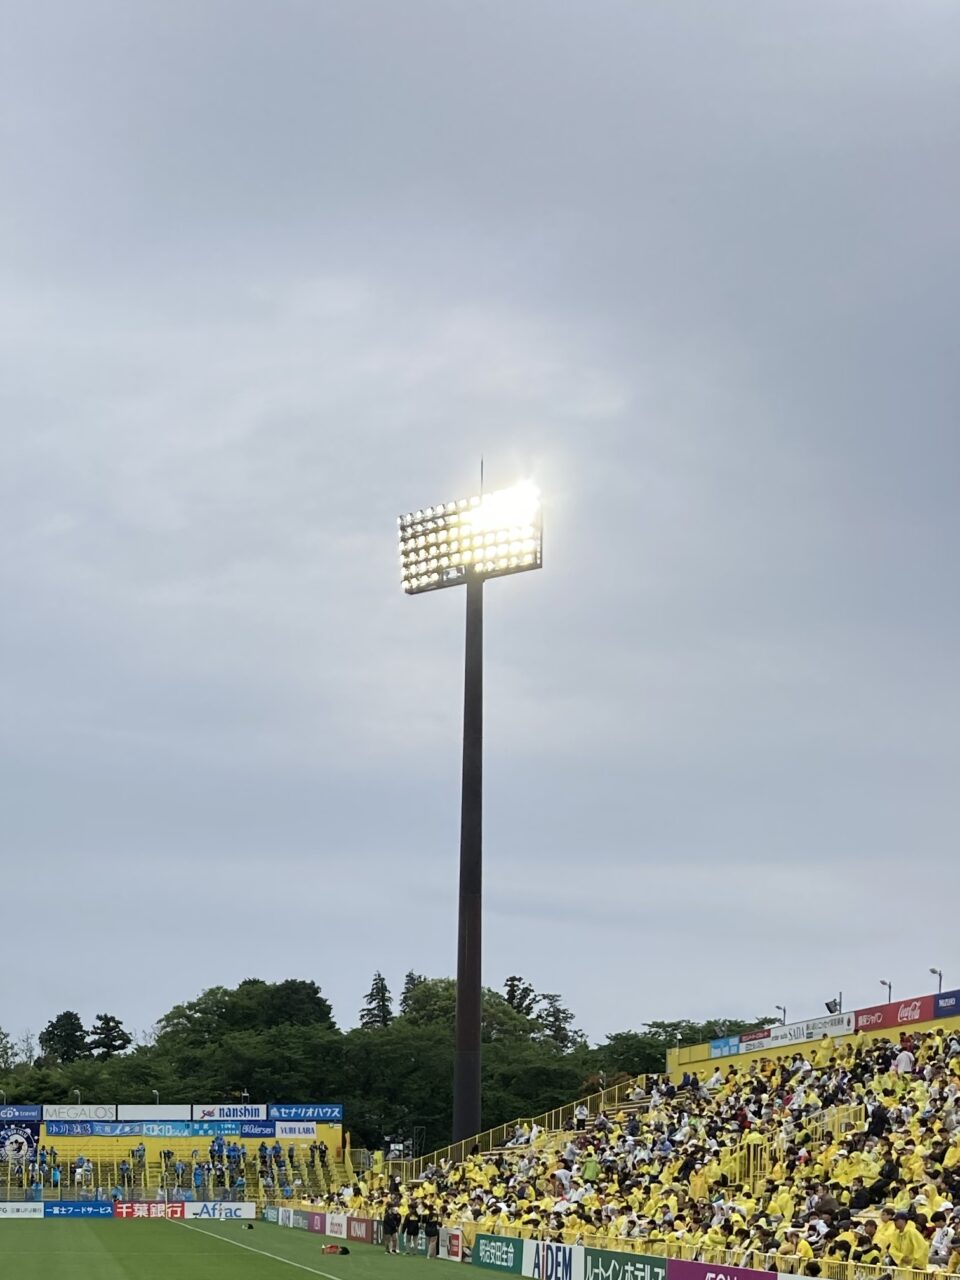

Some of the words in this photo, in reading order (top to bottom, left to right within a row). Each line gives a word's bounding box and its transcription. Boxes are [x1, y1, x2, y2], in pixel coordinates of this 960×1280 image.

[45, 1107, 114, 1119] MEGALOS
[218, 1105, 260, 1118] nanshin
[279, 1107, 341, 1117] セナリオハウス
[116, 1203, 184, 1218] 千葉銀行
[479, 1239, 515, 1268] 明治安田生命
